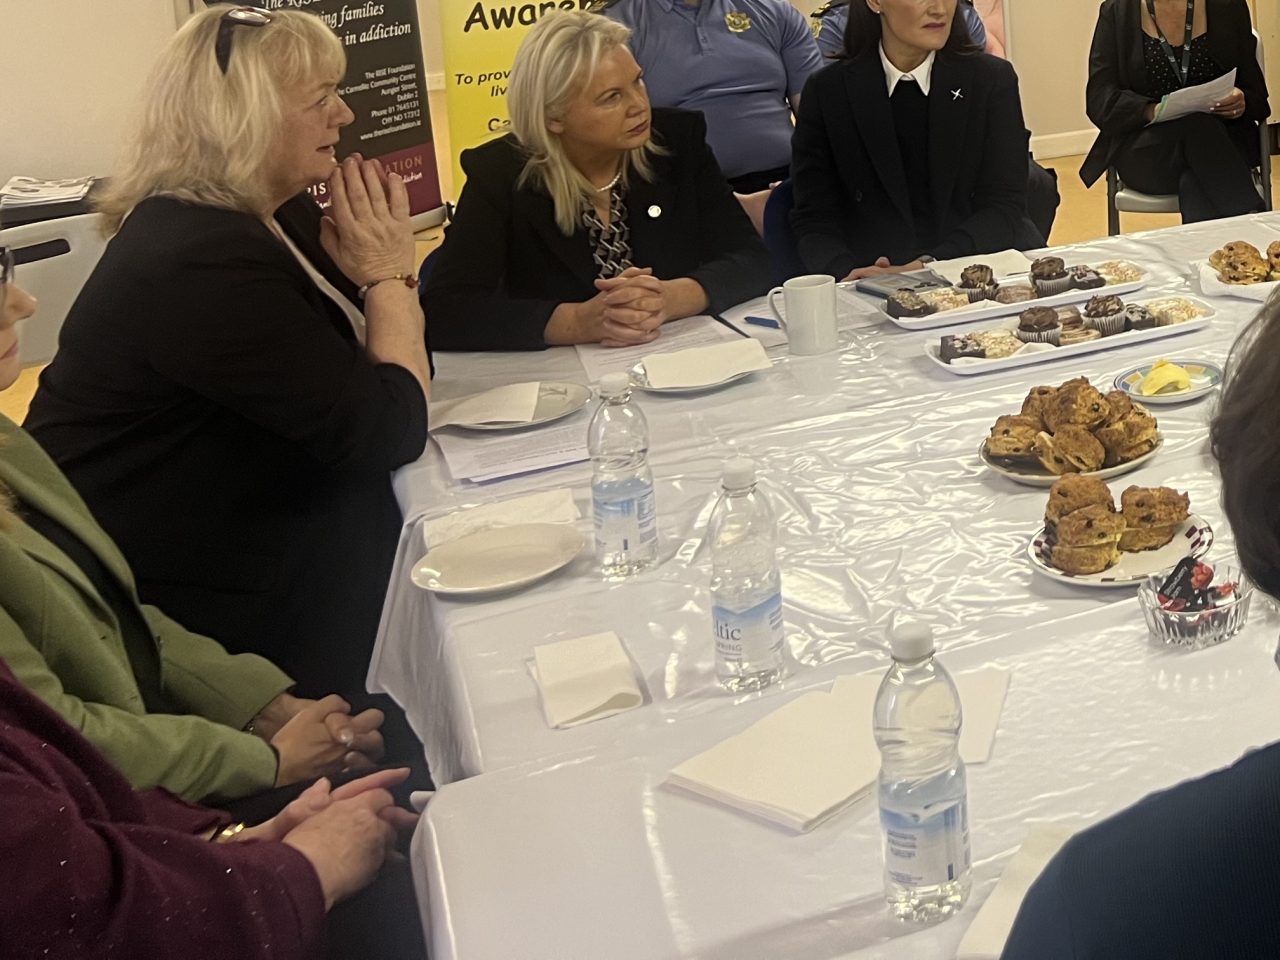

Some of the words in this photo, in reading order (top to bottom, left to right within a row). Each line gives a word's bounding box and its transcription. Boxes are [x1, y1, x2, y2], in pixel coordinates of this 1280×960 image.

[338, 0, 385, 28] families
[345, 31, 356, 46] in
[359, 21, 411, 43] addiction
[454, 73, 474, 86] To
[477, 70, 512, 86] prov
[337, 88, 345, 96] he
[490, 85, 508, 97] liv
[386, 156, 423, 173] ATION
[307, 182, 327, 197] IS
[714, 619, 742, 641] ltic
